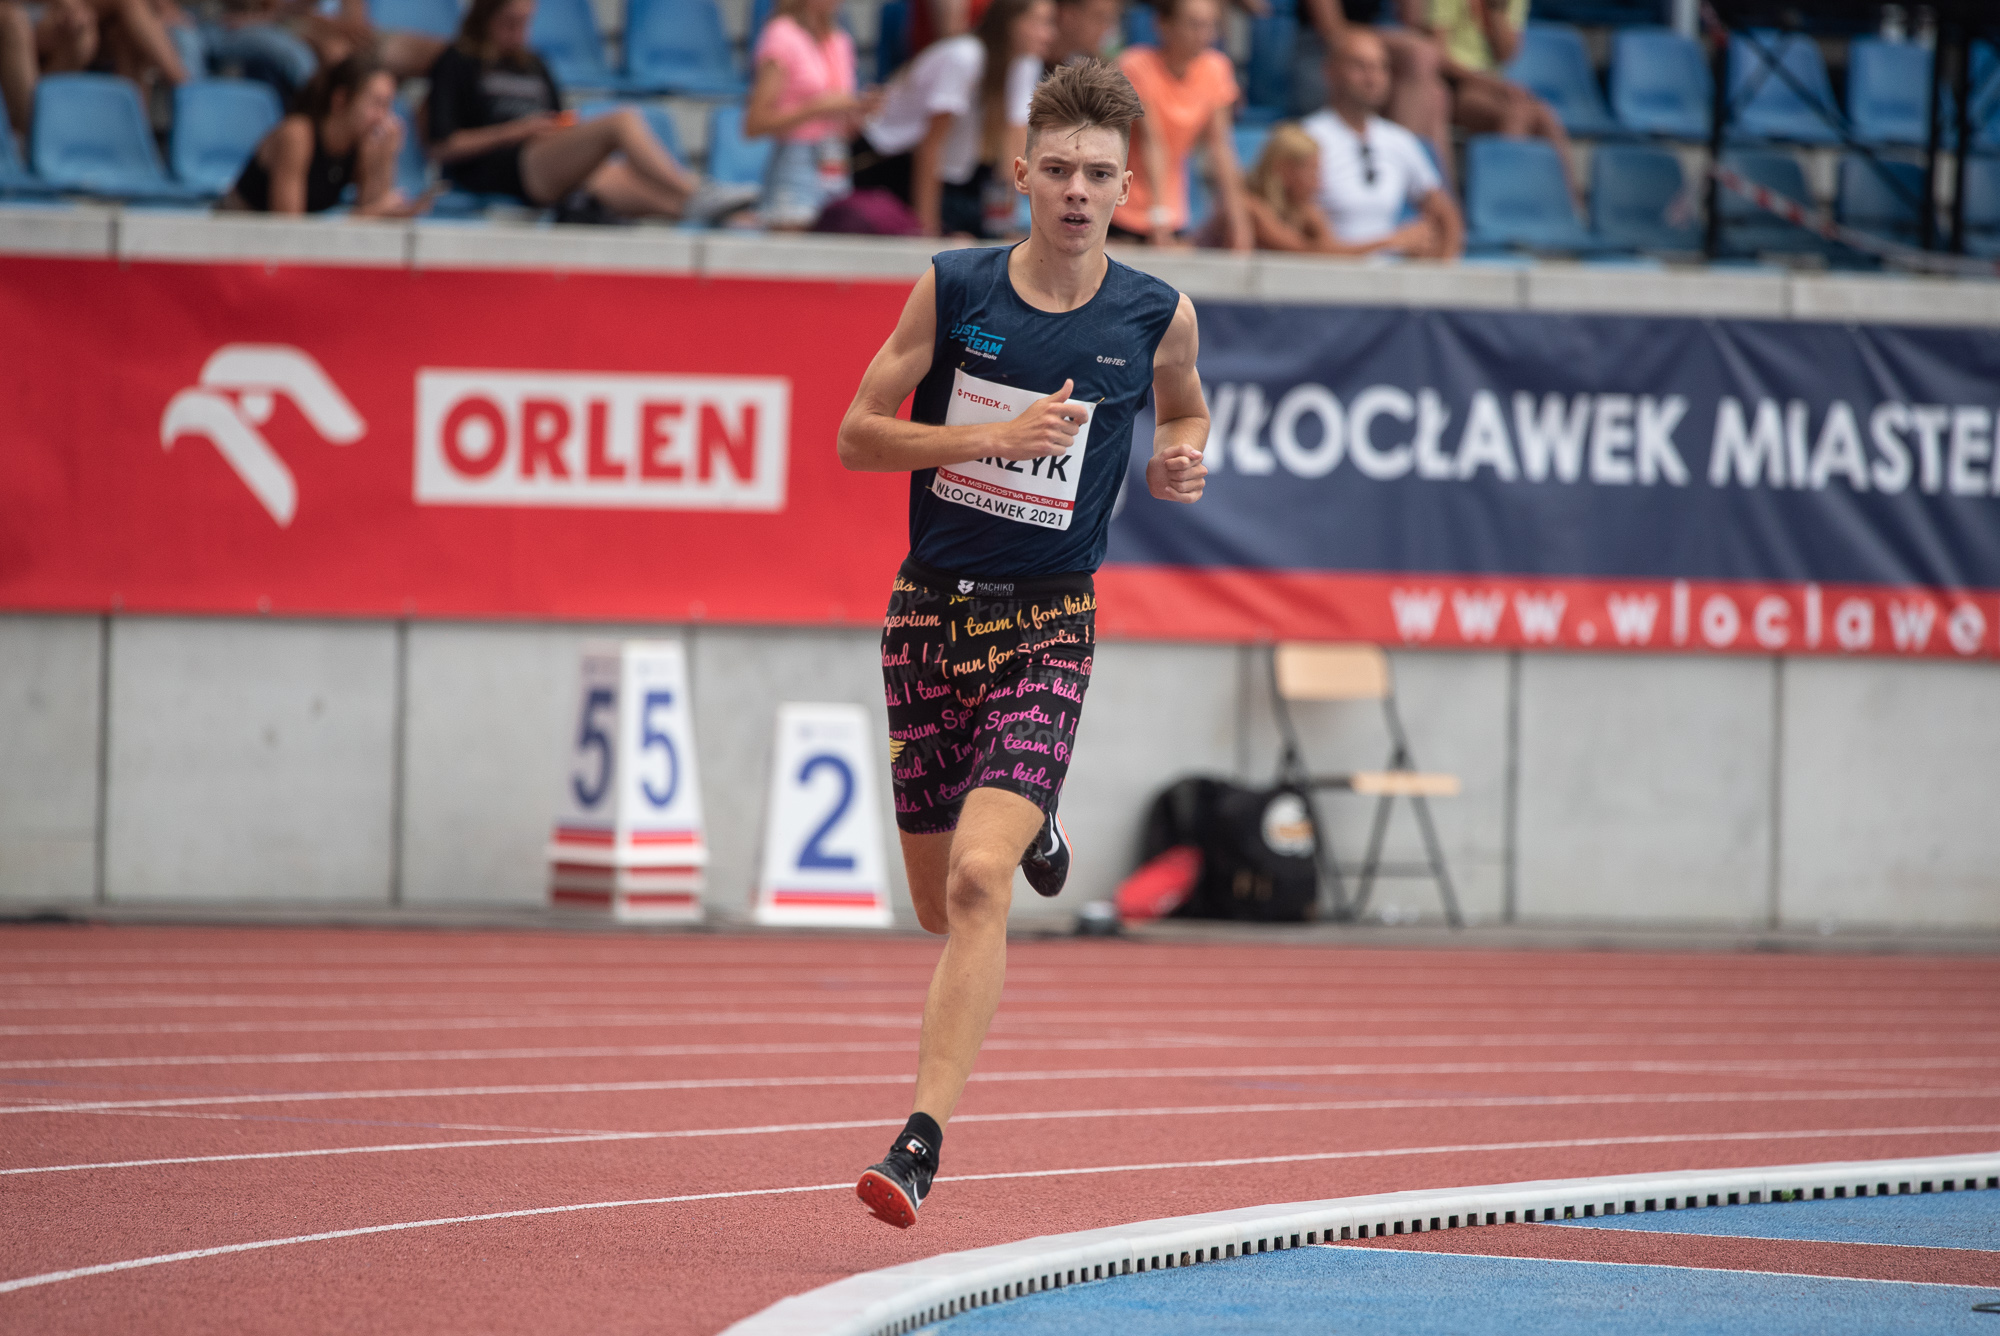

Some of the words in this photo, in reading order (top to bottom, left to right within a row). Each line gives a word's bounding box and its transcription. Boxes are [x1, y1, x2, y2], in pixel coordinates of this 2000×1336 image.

[967, 336, 1003, 355] TEAM
[1103, 356, 1127, 367] HI-TEC
[441, 394, 759, 485] ORLEN
[1707, 395, 2000, 497] MIASTE
[935, 480, 1027, 519] WŁOCŁAWEK
[1029, 508, 1064, 526] 2021
[946, 473, 967, 484] PZLA
[968, 479, 1025, 500] MISTRZOSTWA
[1025, 494, 1054, 506] POLSKI
[1054, 501, 1069, 509] U18
[976, 582, 1015, 592] MACHIKO
[1031, 604, 1063, 630] for
[1063, 592, 1098, 616] kids
[964, 616, 1014, 637] team
[952, 658, 986, 677] run
[988, 645, 1016, 674] for
[1016, 677, 1049, 698] for
[1052, 677, 1082, 704] kids
[985, 705, 1052, 732] Sportu
[641, 689, 680, 807] 5
[1002, 733, 1051, 755] team
[978, 766, 1009, 787] for
[1012, 761, 1052, 789] kids
[796, 753, 858, 869] 2
